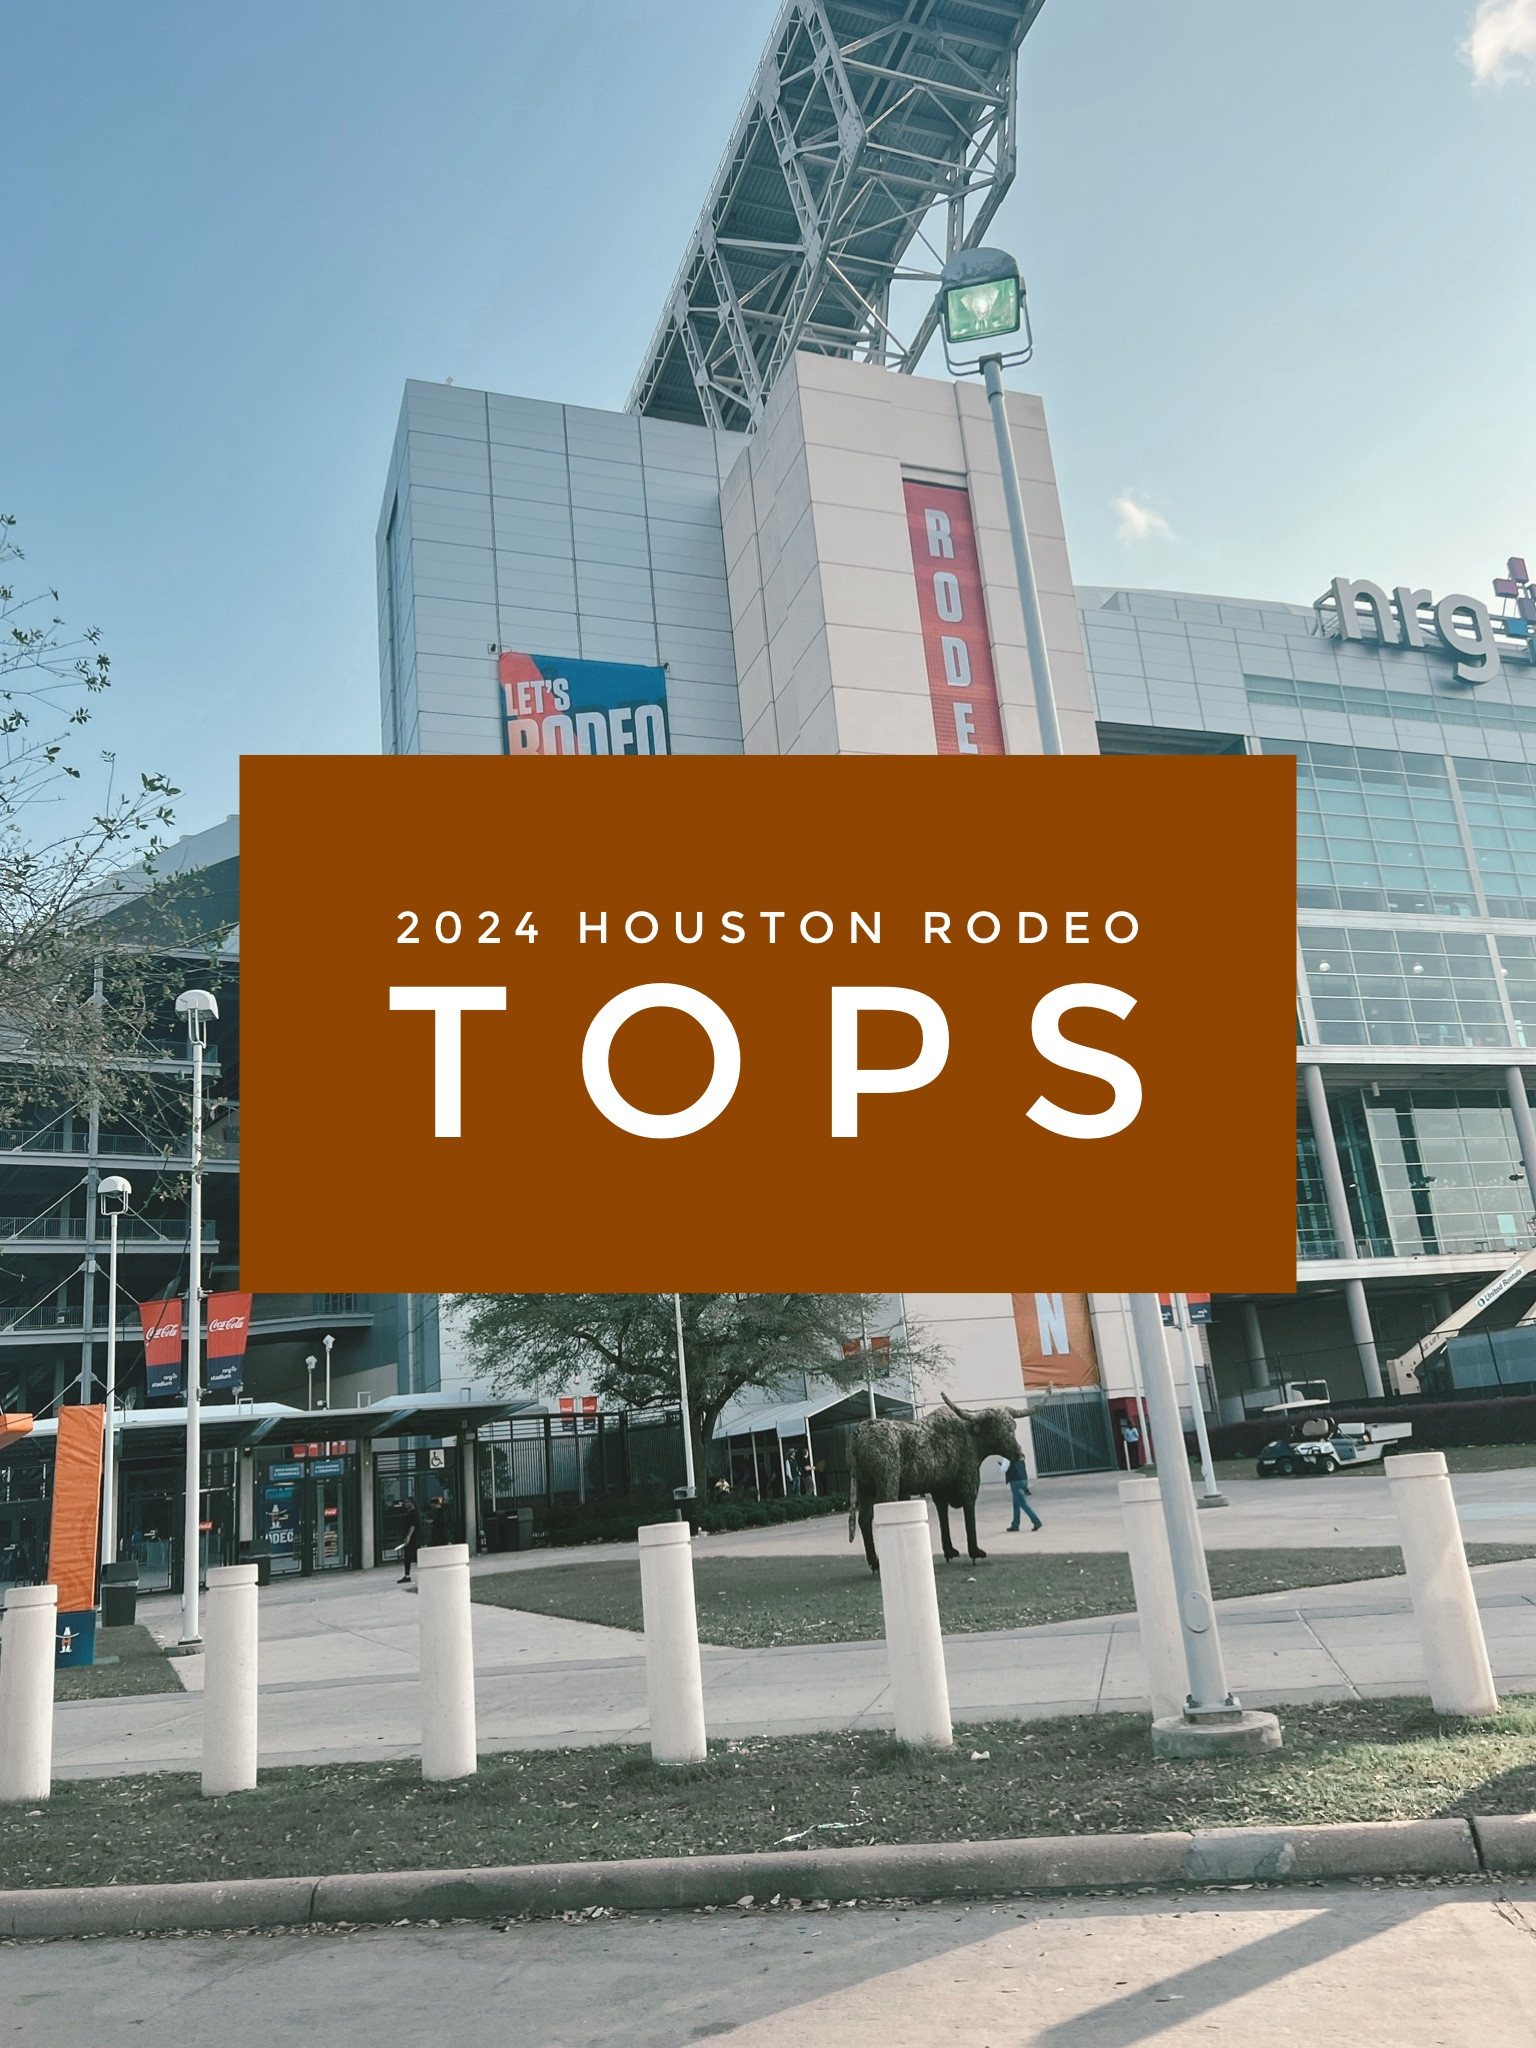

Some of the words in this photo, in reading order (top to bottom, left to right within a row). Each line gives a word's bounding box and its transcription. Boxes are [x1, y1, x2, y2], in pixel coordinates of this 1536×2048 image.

[1331, 577, 1500, 685] nrg
[504, 677, 571, 717] LET'S
[507, 704, 668, 756] RODEO
[1484, 1282, 1504, 1302] United
[1502, 1268, 1523, 1287] Rentals
